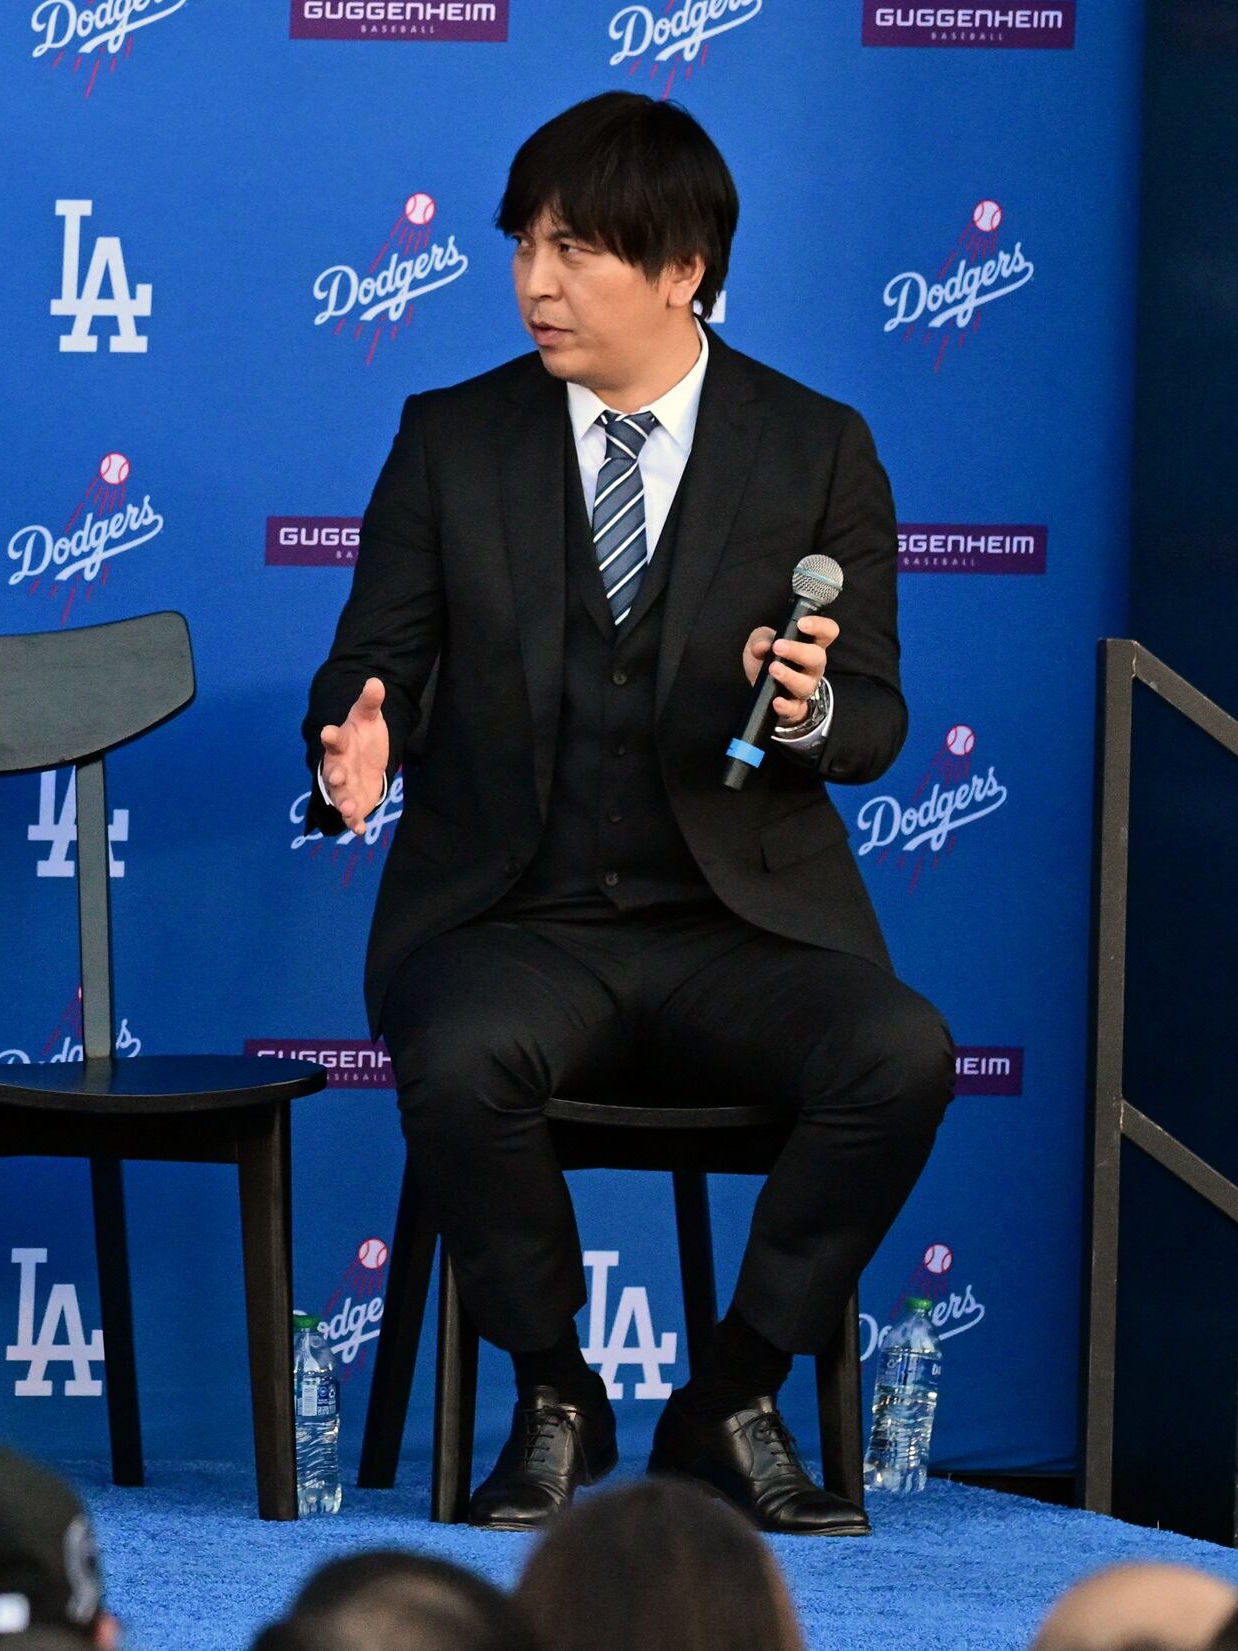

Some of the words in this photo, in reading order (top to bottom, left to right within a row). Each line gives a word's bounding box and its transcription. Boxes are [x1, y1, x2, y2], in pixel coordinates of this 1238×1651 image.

[303, 1, 496, 22] GUGGENHEIM
[360, 24, 435, 34] BASEBALL
[875, 8, 1062, 29] GUGGENHEIM
[50, 200, 152, 353] LA
[313, 235, 468, 326] Dodgers
[883, 243, 1034, 332] Dodgers
[8, 495, 163, 586] Dodgers
[858, 767, 1007, 857] Dodgers
[6, 1248, 105, 1396] LA
[580, 1250, 678, 1400] LA
